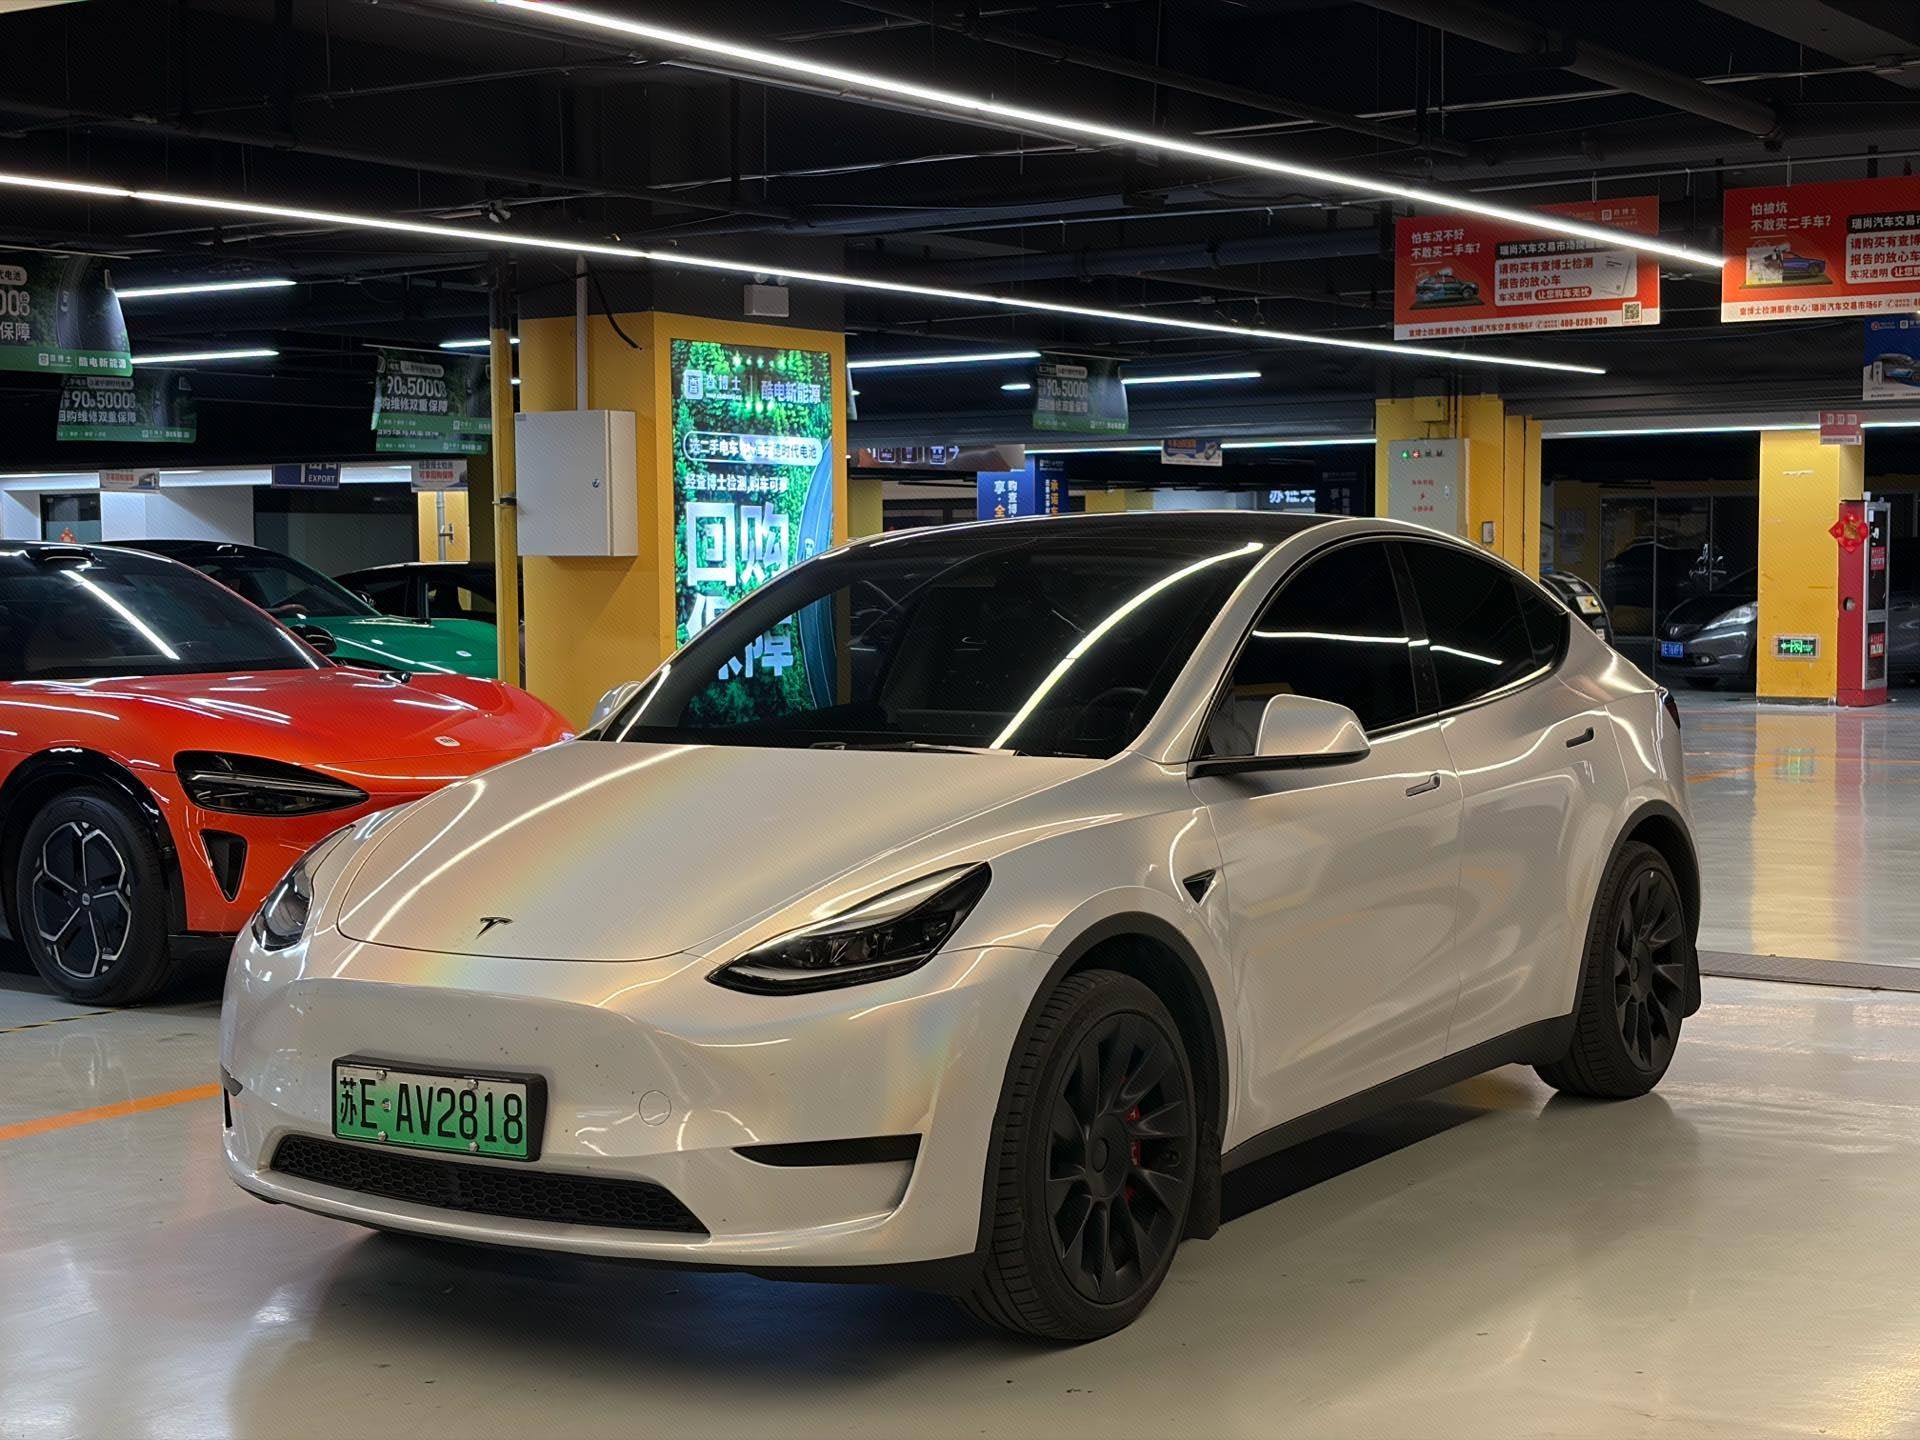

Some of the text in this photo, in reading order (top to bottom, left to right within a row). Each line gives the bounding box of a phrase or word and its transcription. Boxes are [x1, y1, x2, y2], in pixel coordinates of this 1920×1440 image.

[1751, 202, 1788, 215] 怕被坑
[1751, 215, 1832, 231] 不敢买二手车?
[1411, 229, 1465, 245] 怕车况不好
[1411, 243, 1481, 259] 不敢买二手车?
[1498, 258, 1594, 276] 请购买有查博士检测
[1850, 267, 1889, 280] 车况透明
[1498, 274, 1561, 290] 报告的放心车
[1498, 288, 1590, 302] 车况透明 让您购车无忧
[705, 367, 822, 404] 查博士 酷电新能源
[308, 474, 336, 483] EXPORT
[686, 501, 790, 587] 回购
